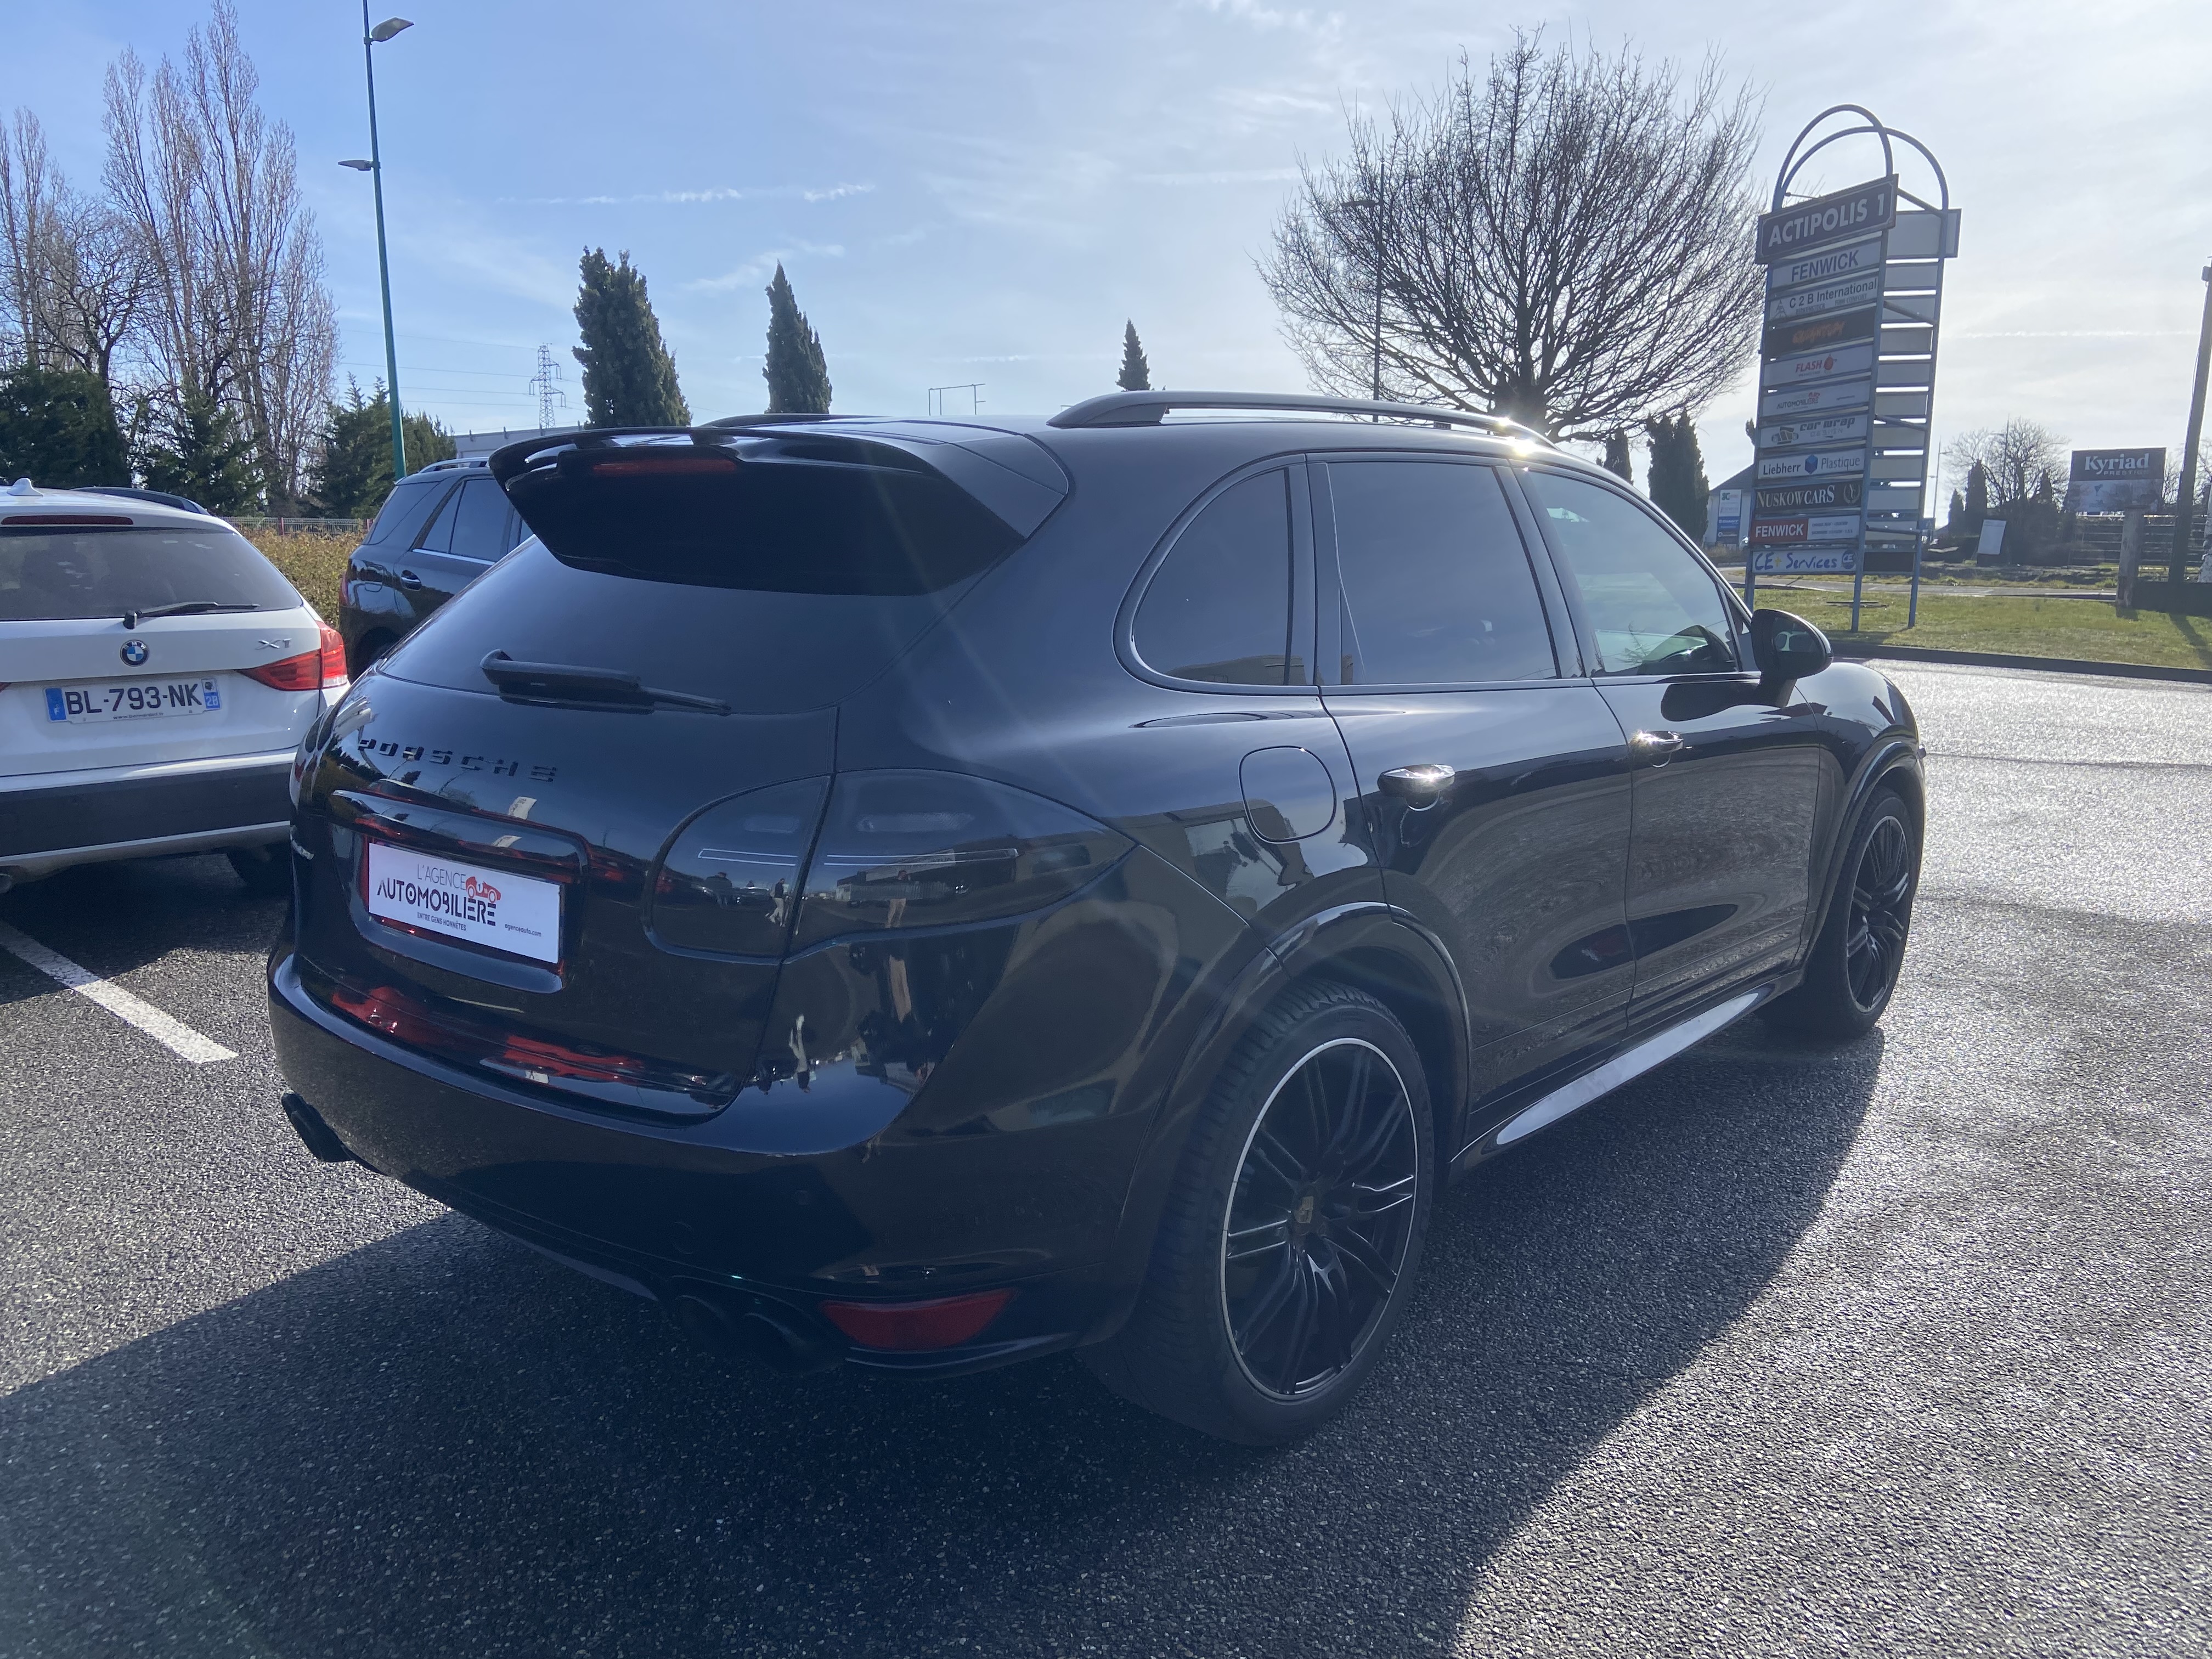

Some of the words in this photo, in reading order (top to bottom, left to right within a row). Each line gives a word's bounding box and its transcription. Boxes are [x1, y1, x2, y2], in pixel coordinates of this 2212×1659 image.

[1768, 198, 1867, 247] ACTIPOLIS
[1877, 193, 1884, 216] 1
[1792, 250, 1859, 281] FENWICK
[1790, 298, 1796, 308] C
[1798, 296, 1804, 306] 2
[1808, 294, 1814, 304] B
[1817, 278, 1877, 302] International
[1795, 360, 1822, 373] FLASH
[1800, 421, 1821, 431] car
[1824, 417, 1855, 428] wrap
[1763, 462, 1801, 475] Liebherr
[1821, 456, 1860, 471] Plastique
[2085, 453, 2149, 475] Kyriad
[1757, 485, 1835, 508] NUSKOWCARS
[1756, 524, 1804, 538] FENWICK
[1786, 552, 1837, 569] Services
[255, 638, 292, 650] X1
[65, 684, 202, 715] BL-793-NK
[206, 696, 218, 707] 2B
[358, 739, 557, 782] PORSCHE
[417, 864, 466, 890] L'AGENCE
[417, 912, 431, 922] ENTRE
[431, 916, 443, 925] GENS
[443, 919, 466, 931] HONNÊTES
[505, 923, 541, 937] agenceauto.com
